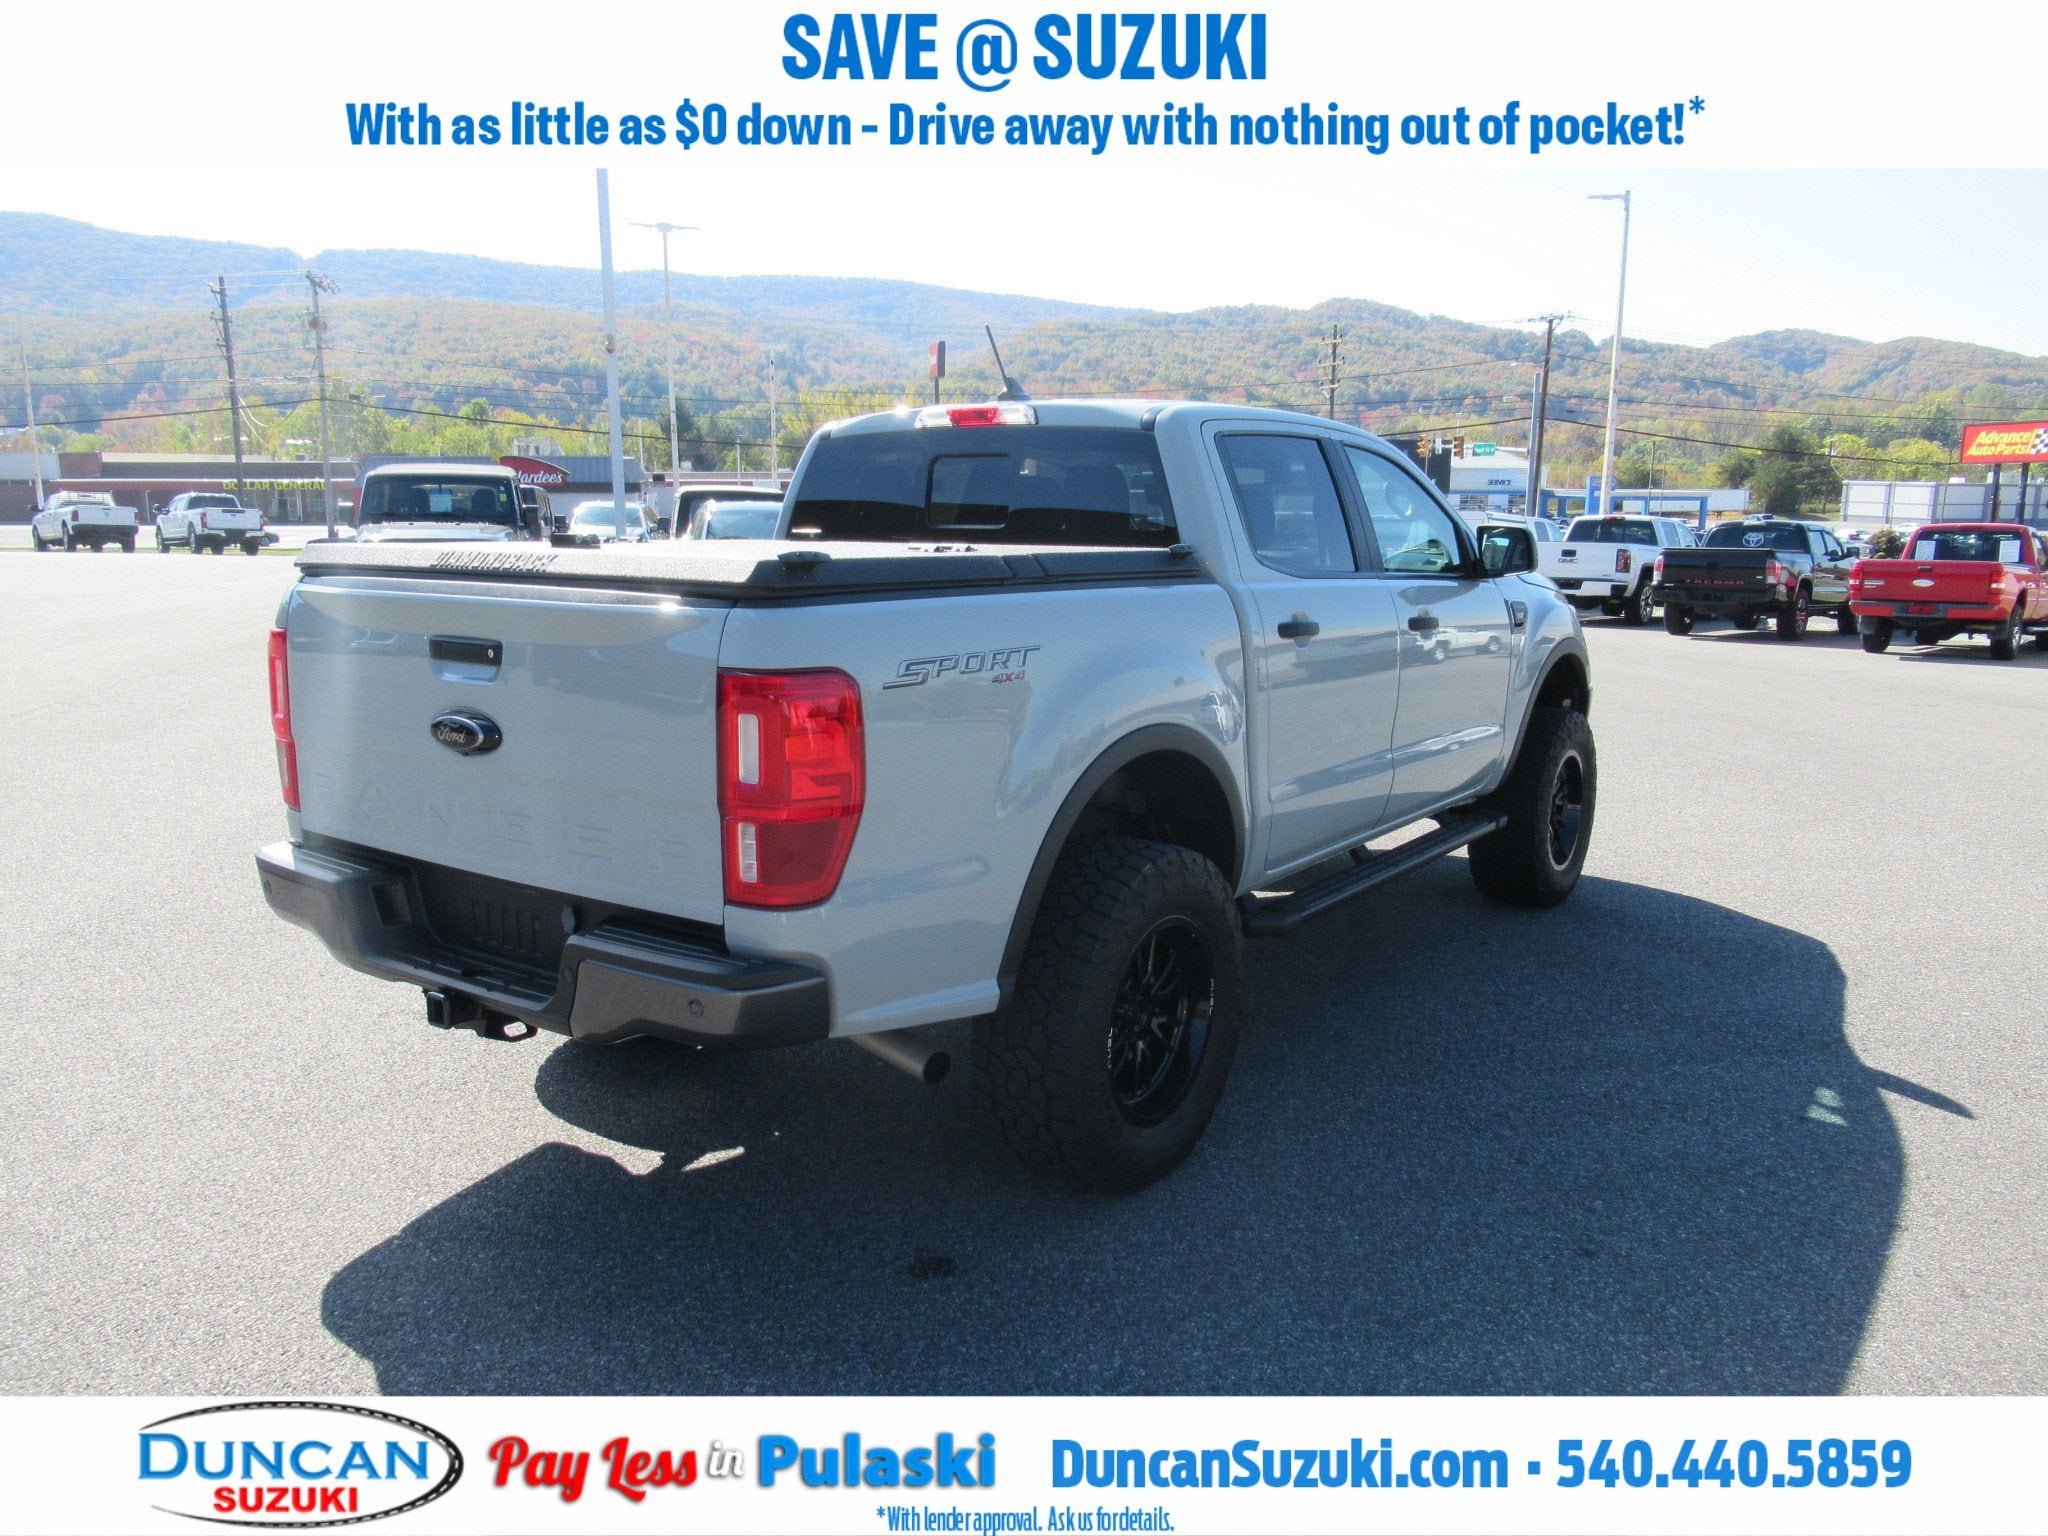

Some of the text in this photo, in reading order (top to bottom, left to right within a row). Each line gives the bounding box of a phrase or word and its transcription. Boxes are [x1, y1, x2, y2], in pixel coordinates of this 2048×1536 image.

[1974, 430, 2031, 444] Advance
[1966, 443, 2027, 457] Auto Parts
[1684, 578, 1745, 586] TACOMA
[882, 644, 1041, 690] SPORT
[437, 721, 468, 744] Ford
